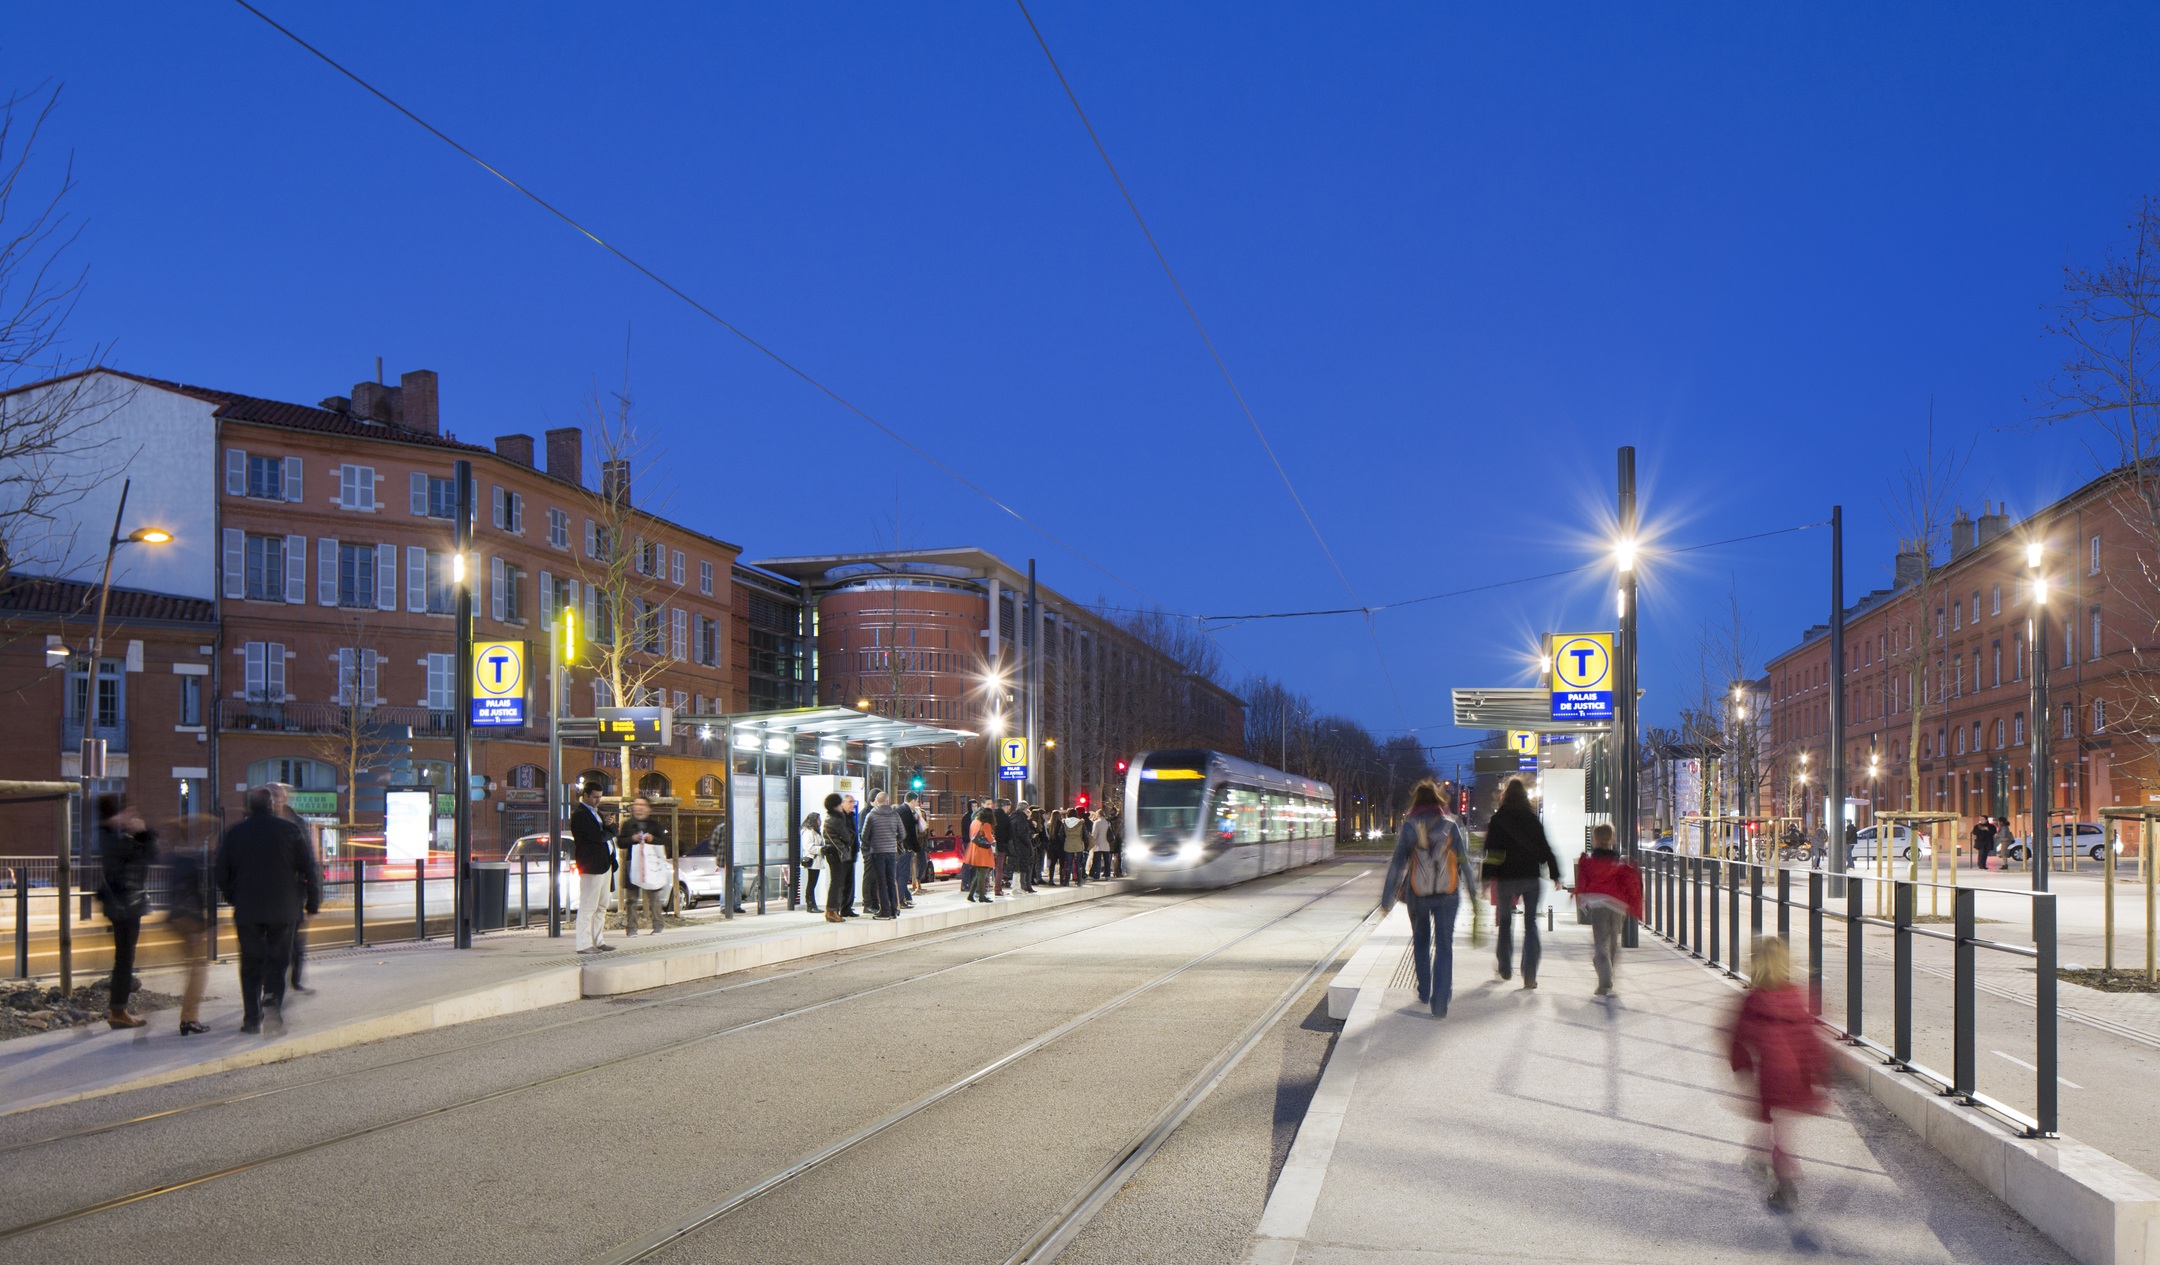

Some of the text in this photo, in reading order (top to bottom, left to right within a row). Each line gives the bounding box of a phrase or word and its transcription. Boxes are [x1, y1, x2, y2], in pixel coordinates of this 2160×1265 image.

[1569, 648, 1594, 677] T
[488, 656, 508, 683] T
[1567, 693, 1597, 701] PALAIS
[485, 699, 511, 707] PALAIS
[1560, 702, 1605, 710] DE JUSTICE
[479, 708, 518, 717] DE JUSTICE
[1517, 734, 1529, 748] T
[1008, 744, 1019, 758] T
